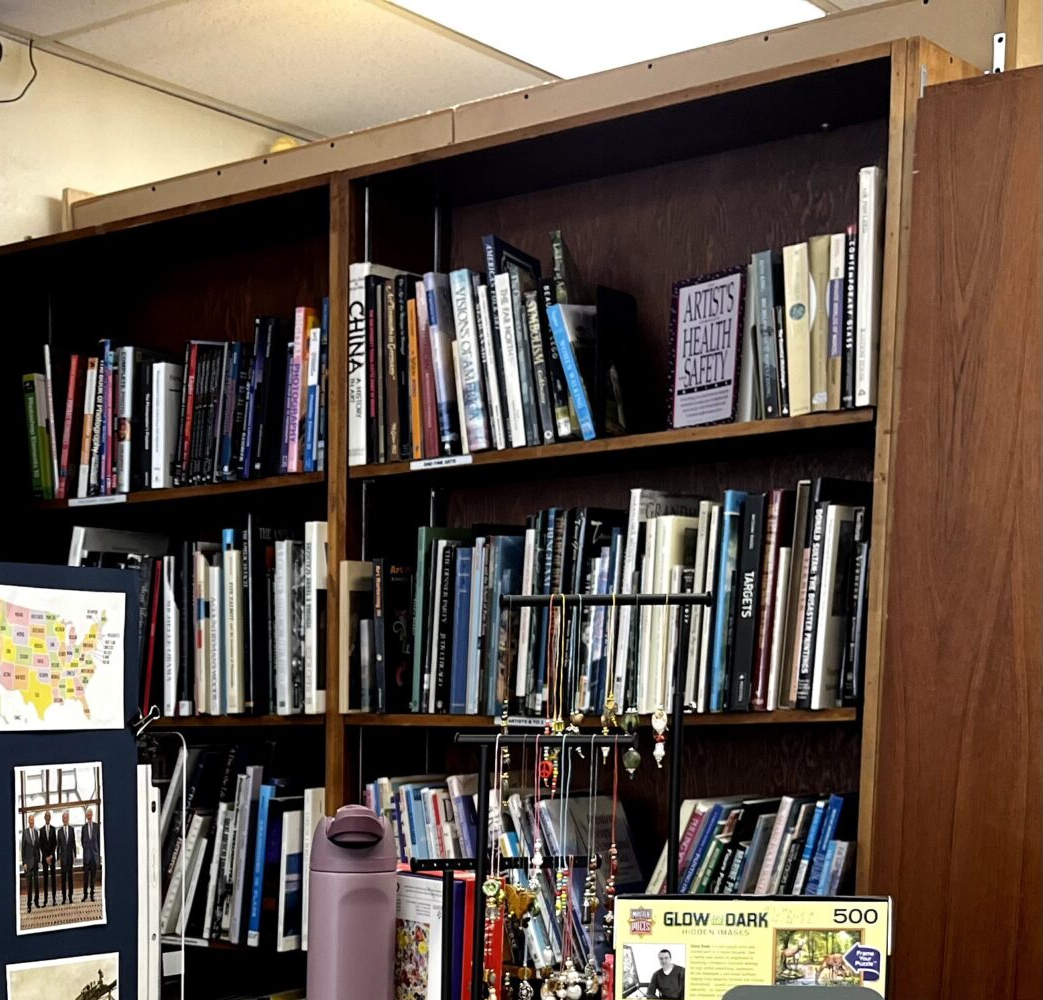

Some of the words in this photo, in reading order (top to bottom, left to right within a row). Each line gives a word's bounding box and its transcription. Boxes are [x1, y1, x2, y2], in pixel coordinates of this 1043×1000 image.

[454, 290, 470, 336] VISIONS
[683, 281, 735, 324] ARTIST'S
[349, 301, 365, 375] CHINA
[462, 336, 471, 355] OF
[682, 319, 733, 358] HEALTH
[684, 351, 728, 388] SAFETY
[289, 364, 300, 442] PHOTOGRAPHY
[463, 360, 478, 421] AMERICA
[741, 571, 755, 618] TARGETS
[663, 912, 711, 928] GLOW
[725, 912, 768, 928] DARK
[718, 929, 750, 937] IMAGES
[833, 908, 879, 925] 500
